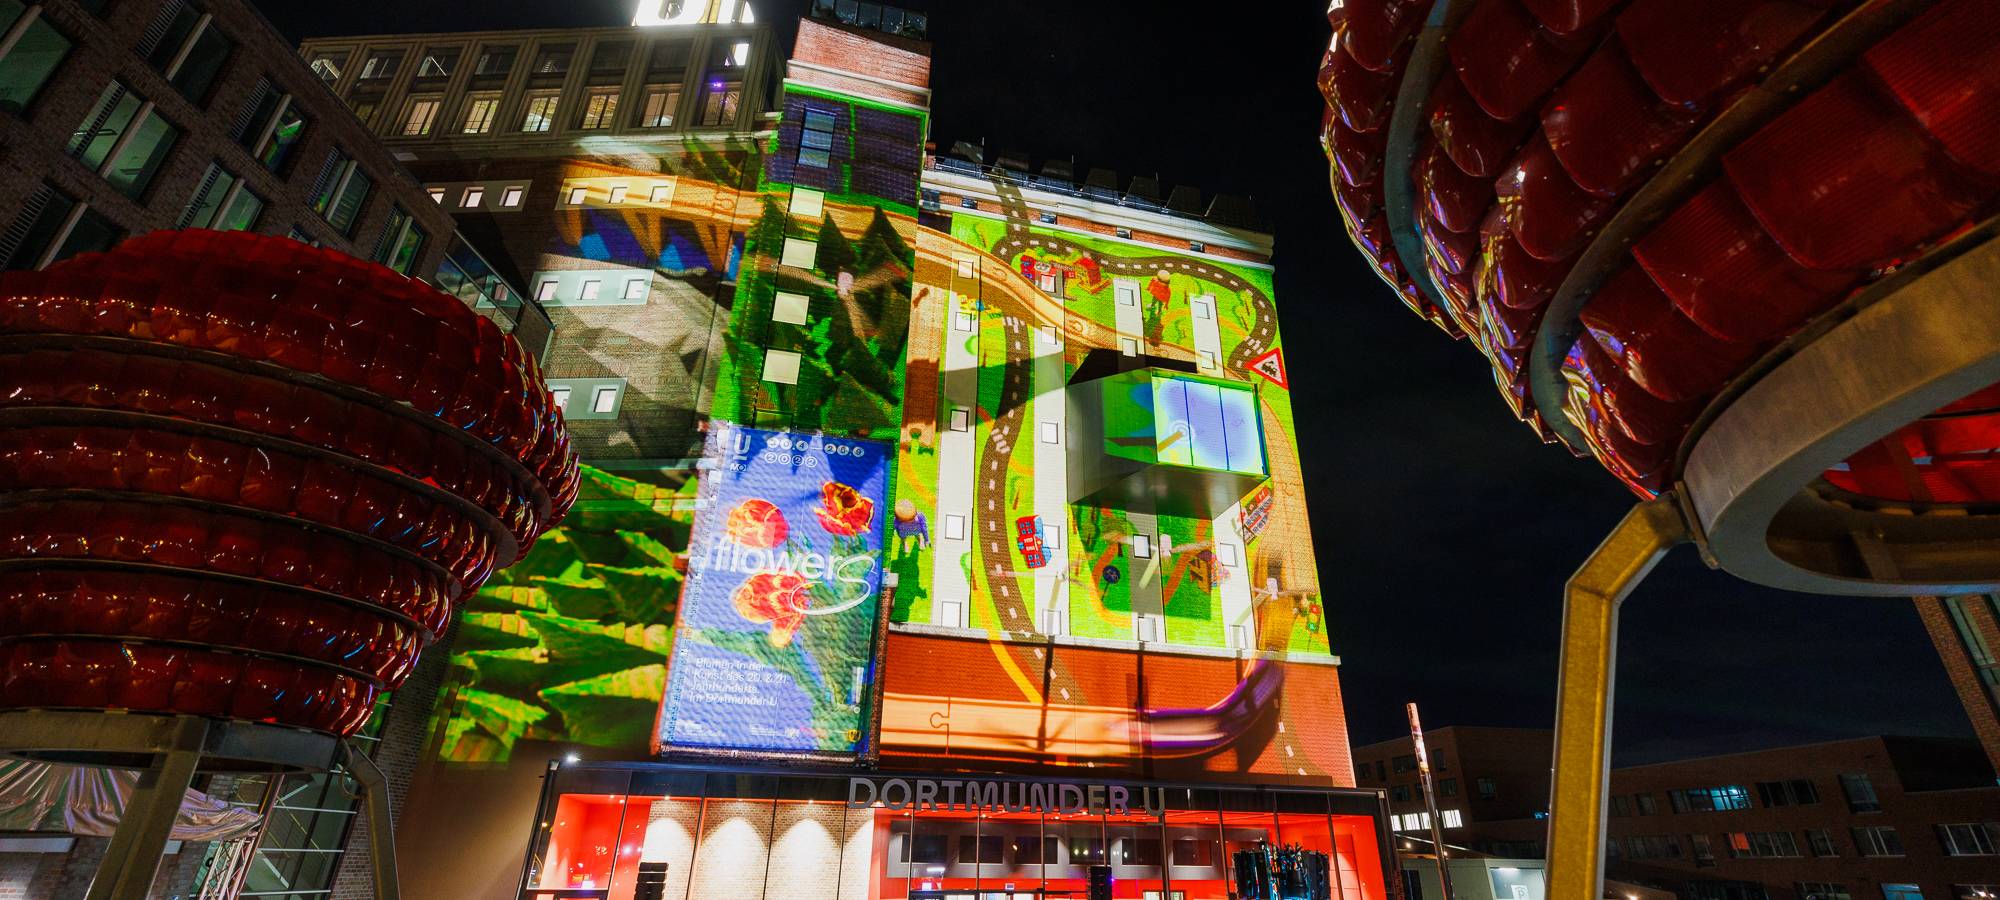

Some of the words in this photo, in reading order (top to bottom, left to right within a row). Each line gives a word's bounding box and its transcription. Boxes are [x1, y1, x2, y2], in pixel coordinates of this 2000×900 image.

[765, 451, 818, 468] 2022
[849, 777, 1130, 816] DORTMUNDER
[1143, 787, 1165, 817] U
